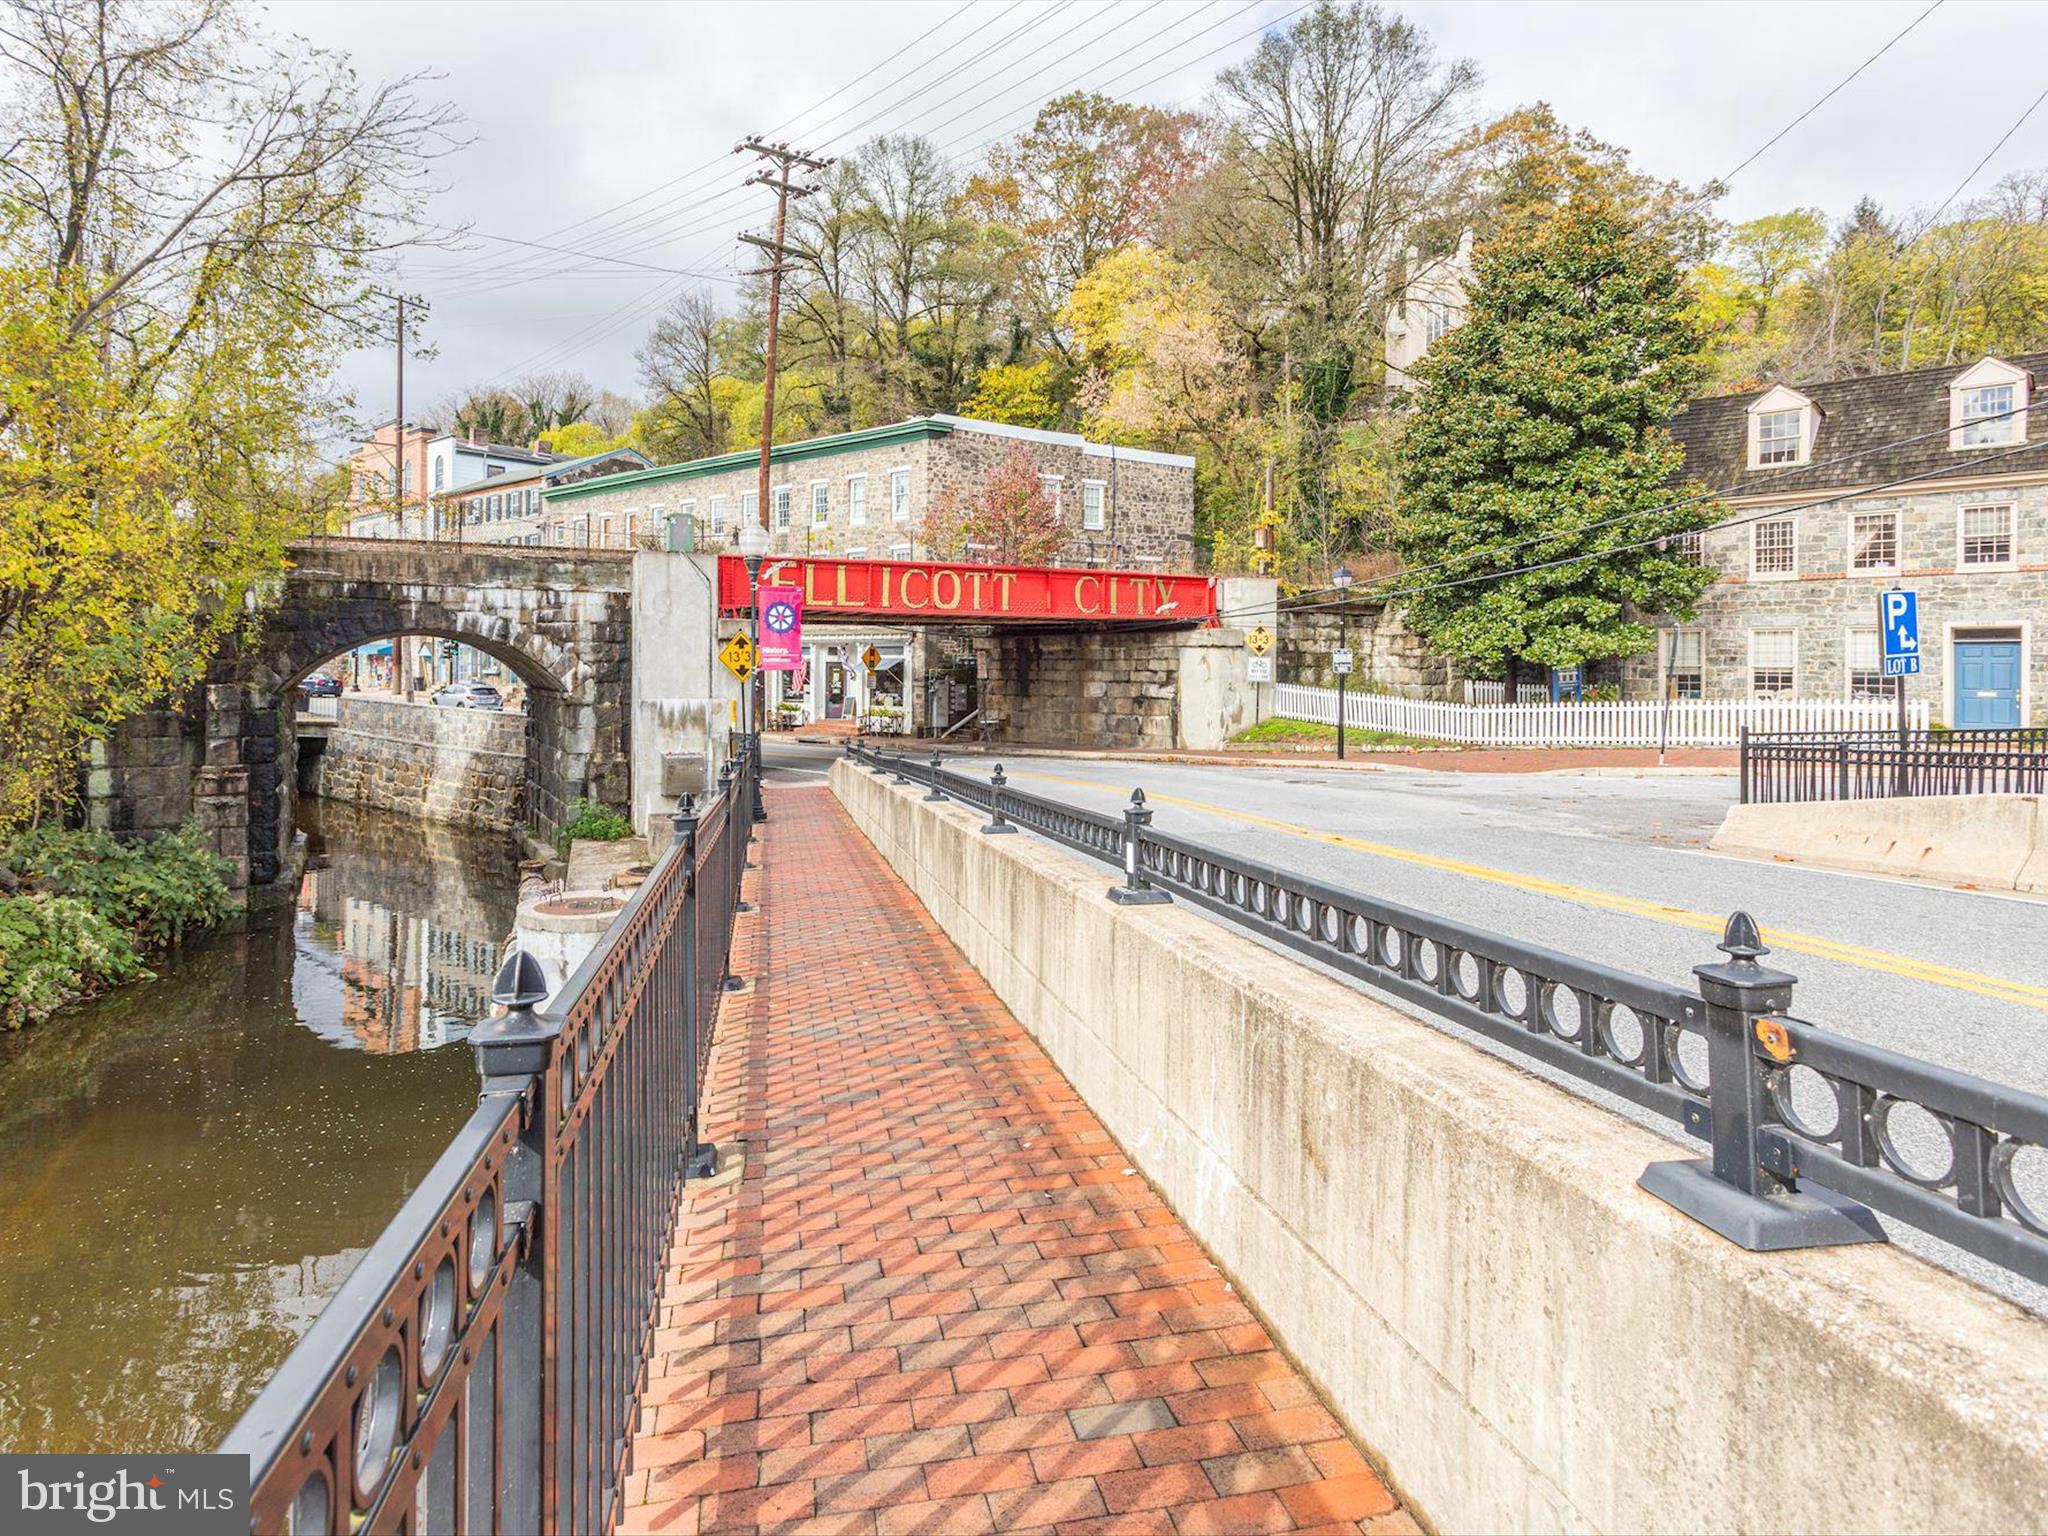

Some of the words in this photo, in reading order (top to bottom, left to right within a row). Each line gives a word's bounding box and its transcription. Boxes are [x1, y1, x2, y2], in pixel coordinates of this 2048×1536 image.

[770, 561, 1016, 611] ELLICOTT
[1074, 575, 1177, 617] CITY
[1888, 594, 1907, 630] P
[1887, 658, 1907, 674] LOT
[1910, 657, 1918, 672] B
